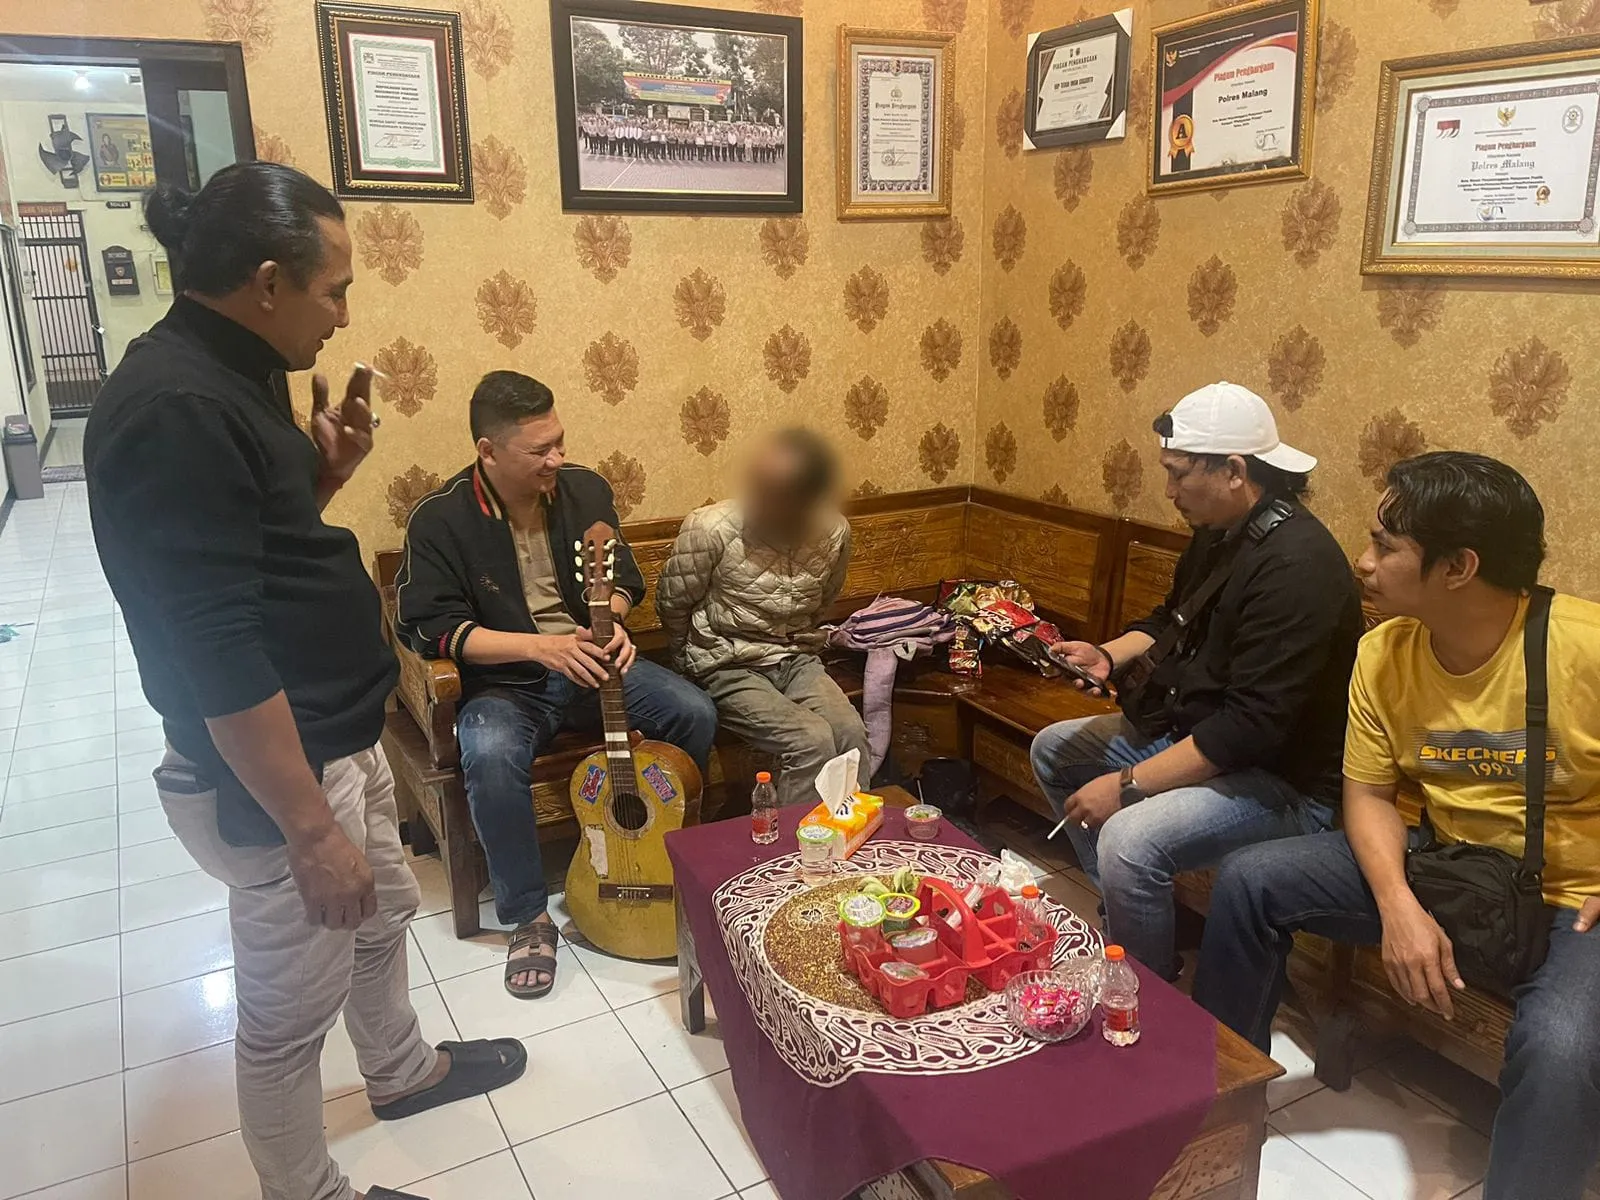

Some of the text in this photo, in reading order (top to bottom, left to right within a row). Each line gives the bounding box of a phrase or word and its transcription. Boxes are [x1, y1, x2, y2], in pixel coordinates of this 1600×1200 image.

[1214, 62, 1275, 82] Piagam Penghargaan
[1218, 88, 1268, 104] Polres Malang
[1175, 123, 1188, 139] A
[1474, 141, 1537, 152] Piagam Penghargaan
[1471, 159, 1535, 172] Polres Malang
[1419, 745, 1557, 765] SKECHERS
